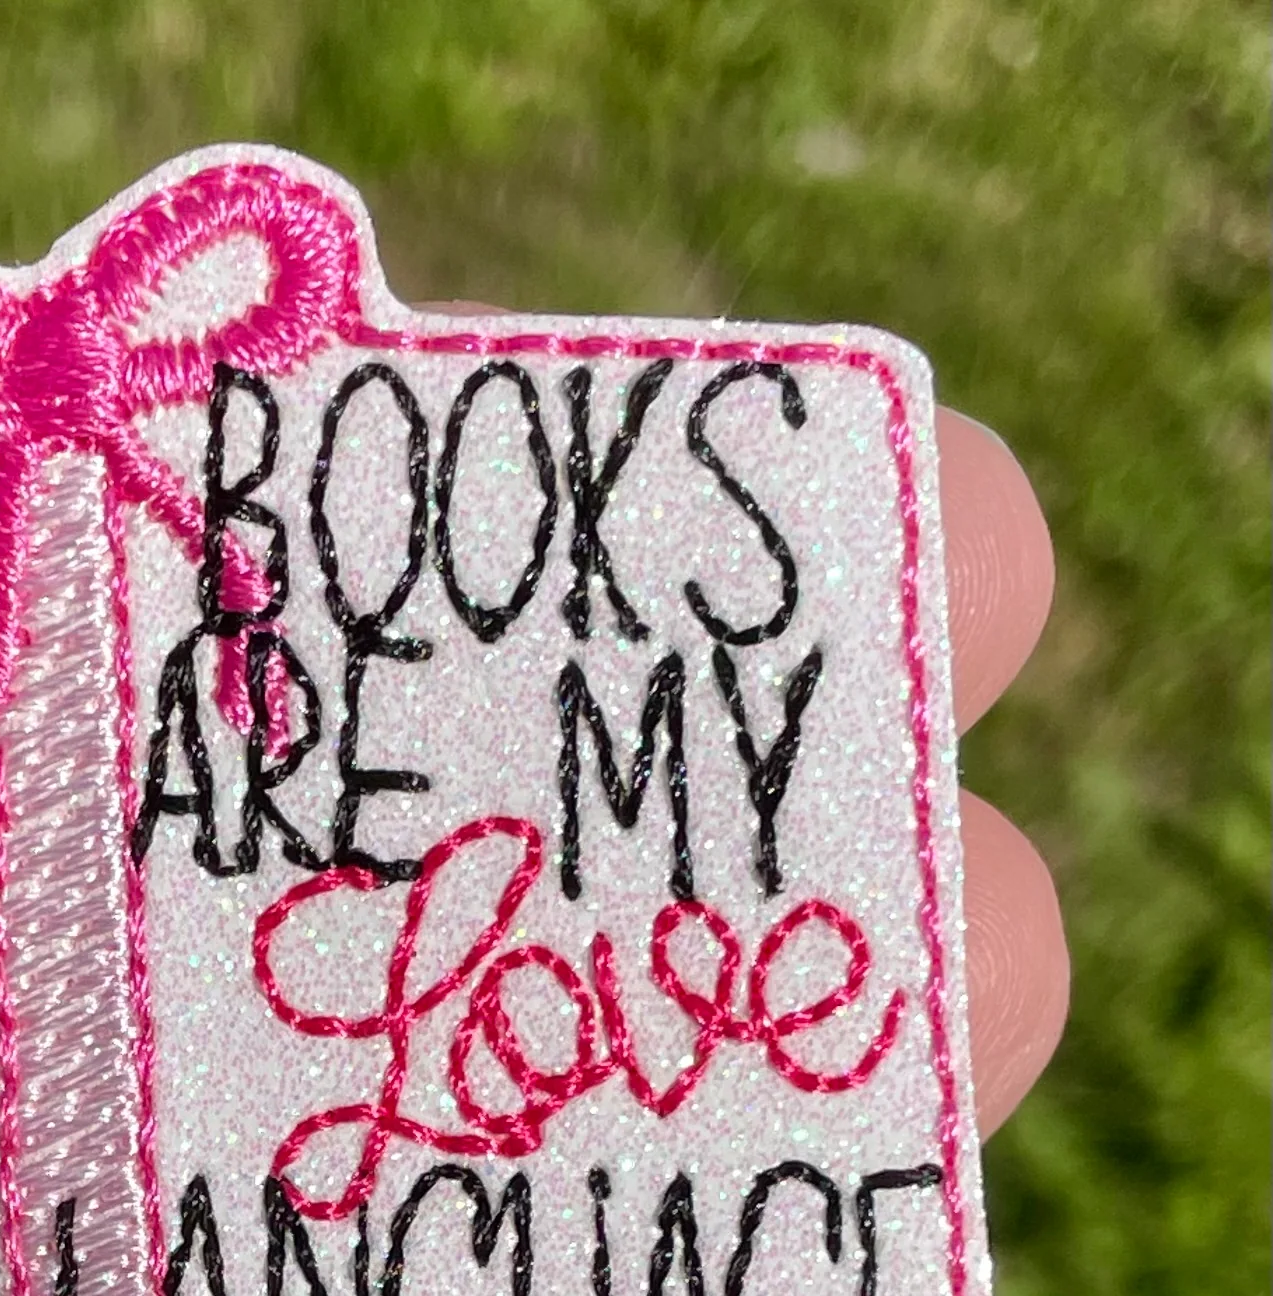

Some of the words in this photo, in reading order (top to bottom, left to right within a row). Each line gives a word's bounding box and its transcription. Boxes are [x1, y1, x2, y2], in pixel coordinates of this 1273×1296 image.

[196, 360, 805, 641] BOOKS
[133, 622, 430, 879] ARE
[557, 643, 823, 897] MY
[253, 816, 902, 1220] Love
